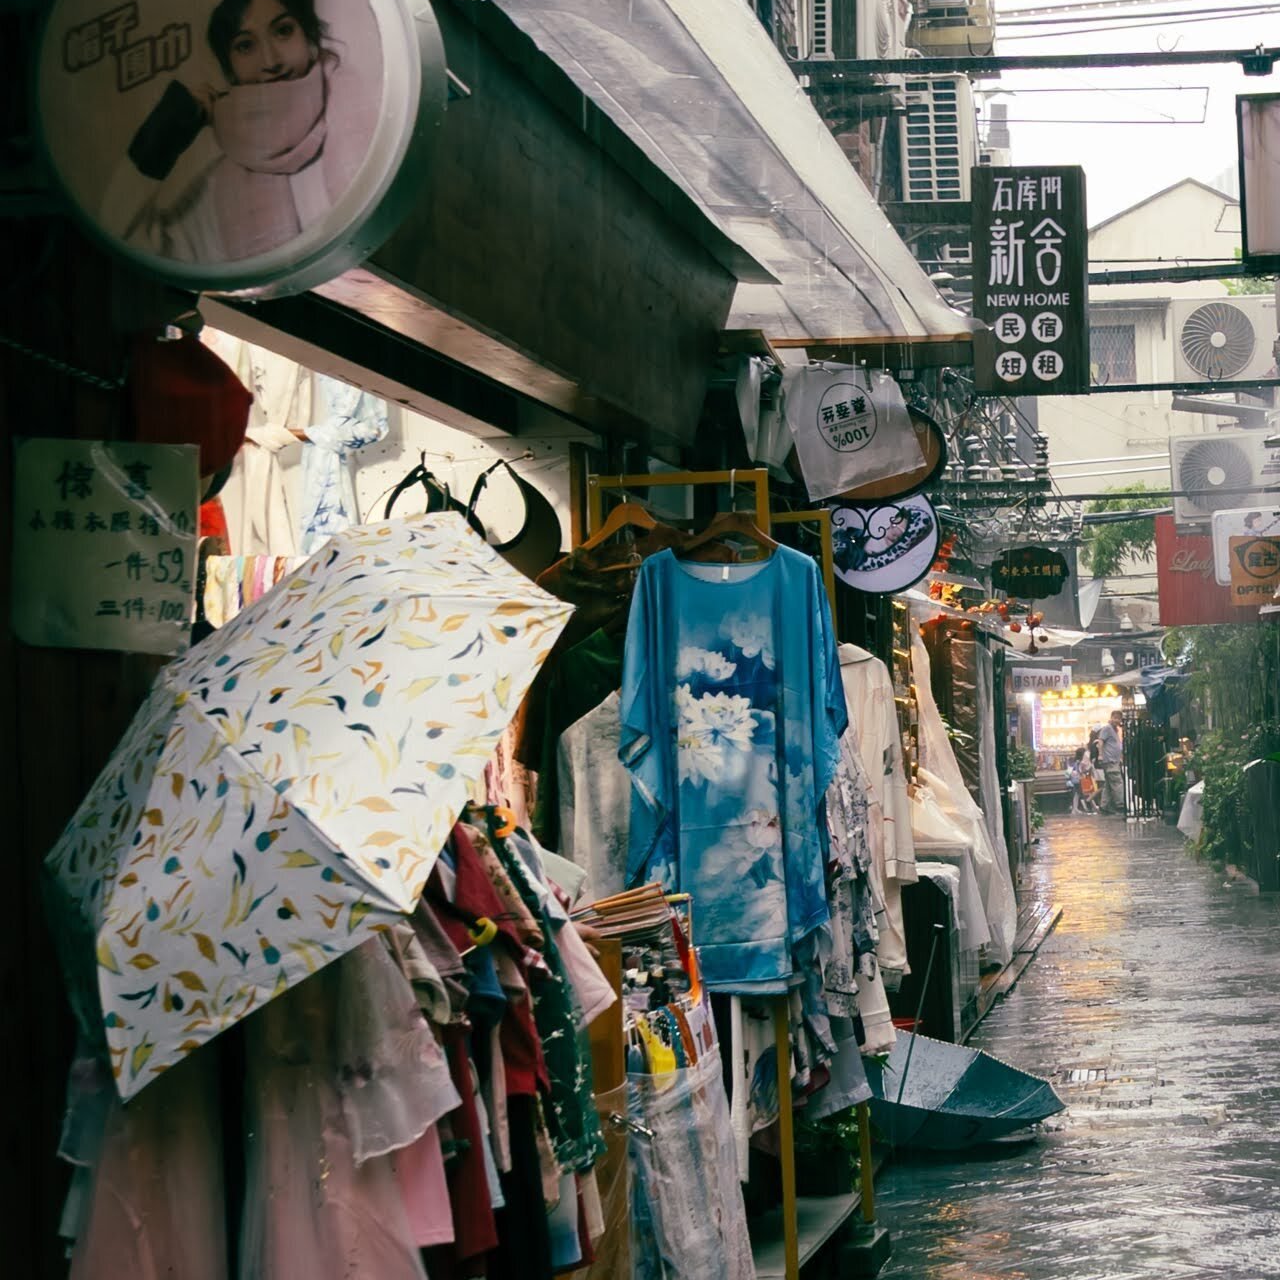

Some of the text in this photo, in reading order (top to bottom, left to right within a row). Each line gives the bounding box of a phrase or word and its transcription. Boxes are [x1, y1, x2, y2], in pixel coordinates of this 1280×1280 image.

[988, 217, 1067, 287] 新舍
[986, 292, 1070, 307] NEW HOME
[1000, 316, 1058, 339] 民宿
[1000, 354, 1058, 377] 短租
[832, 426, 870, 450] 100%
[1023, 675, 1061, 688] STAMP
